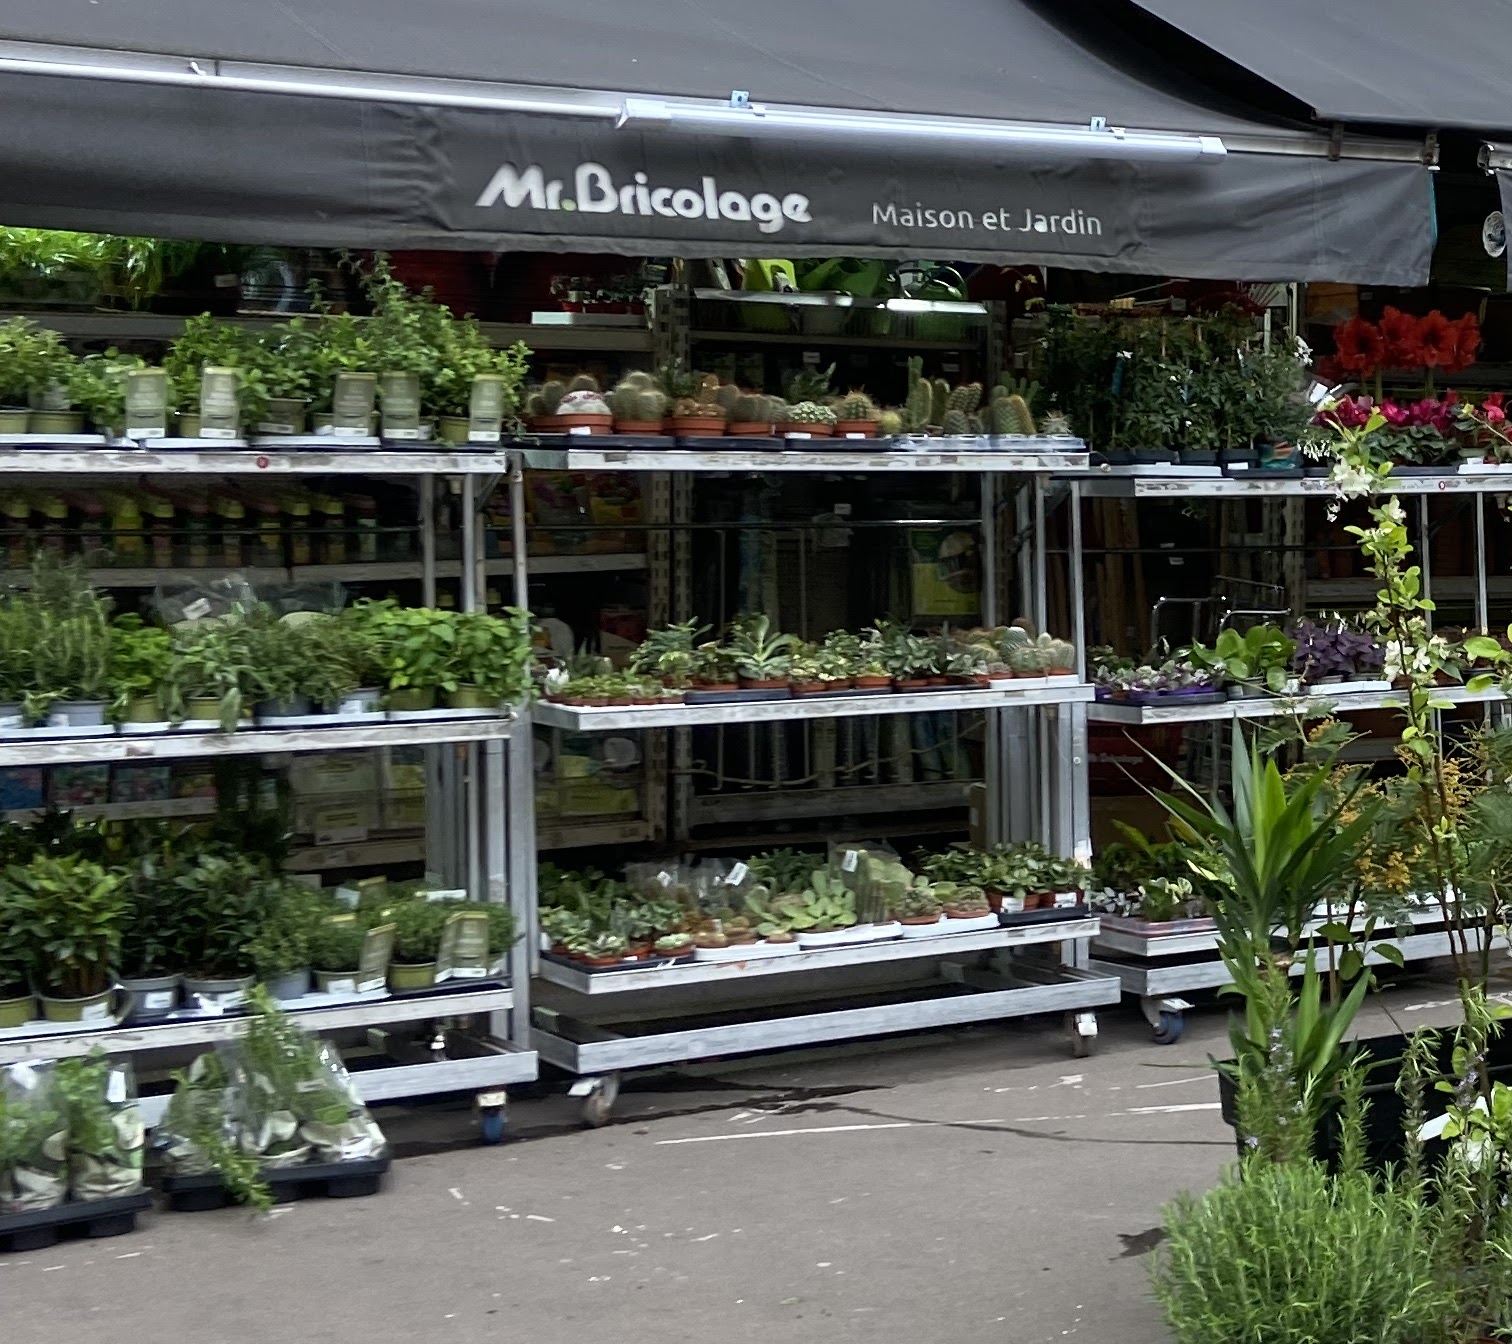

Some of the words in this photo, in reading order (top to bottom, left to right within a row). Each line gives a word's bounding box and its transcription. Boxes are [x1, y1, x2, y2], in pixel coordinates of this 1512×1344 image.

[475, 161, 813, 234] Mr.Bricolage
[872, 202, 974, 230] Maison
[981, 208, 1012, 231] et
[1018, 209, 1102, 236] Jardin
